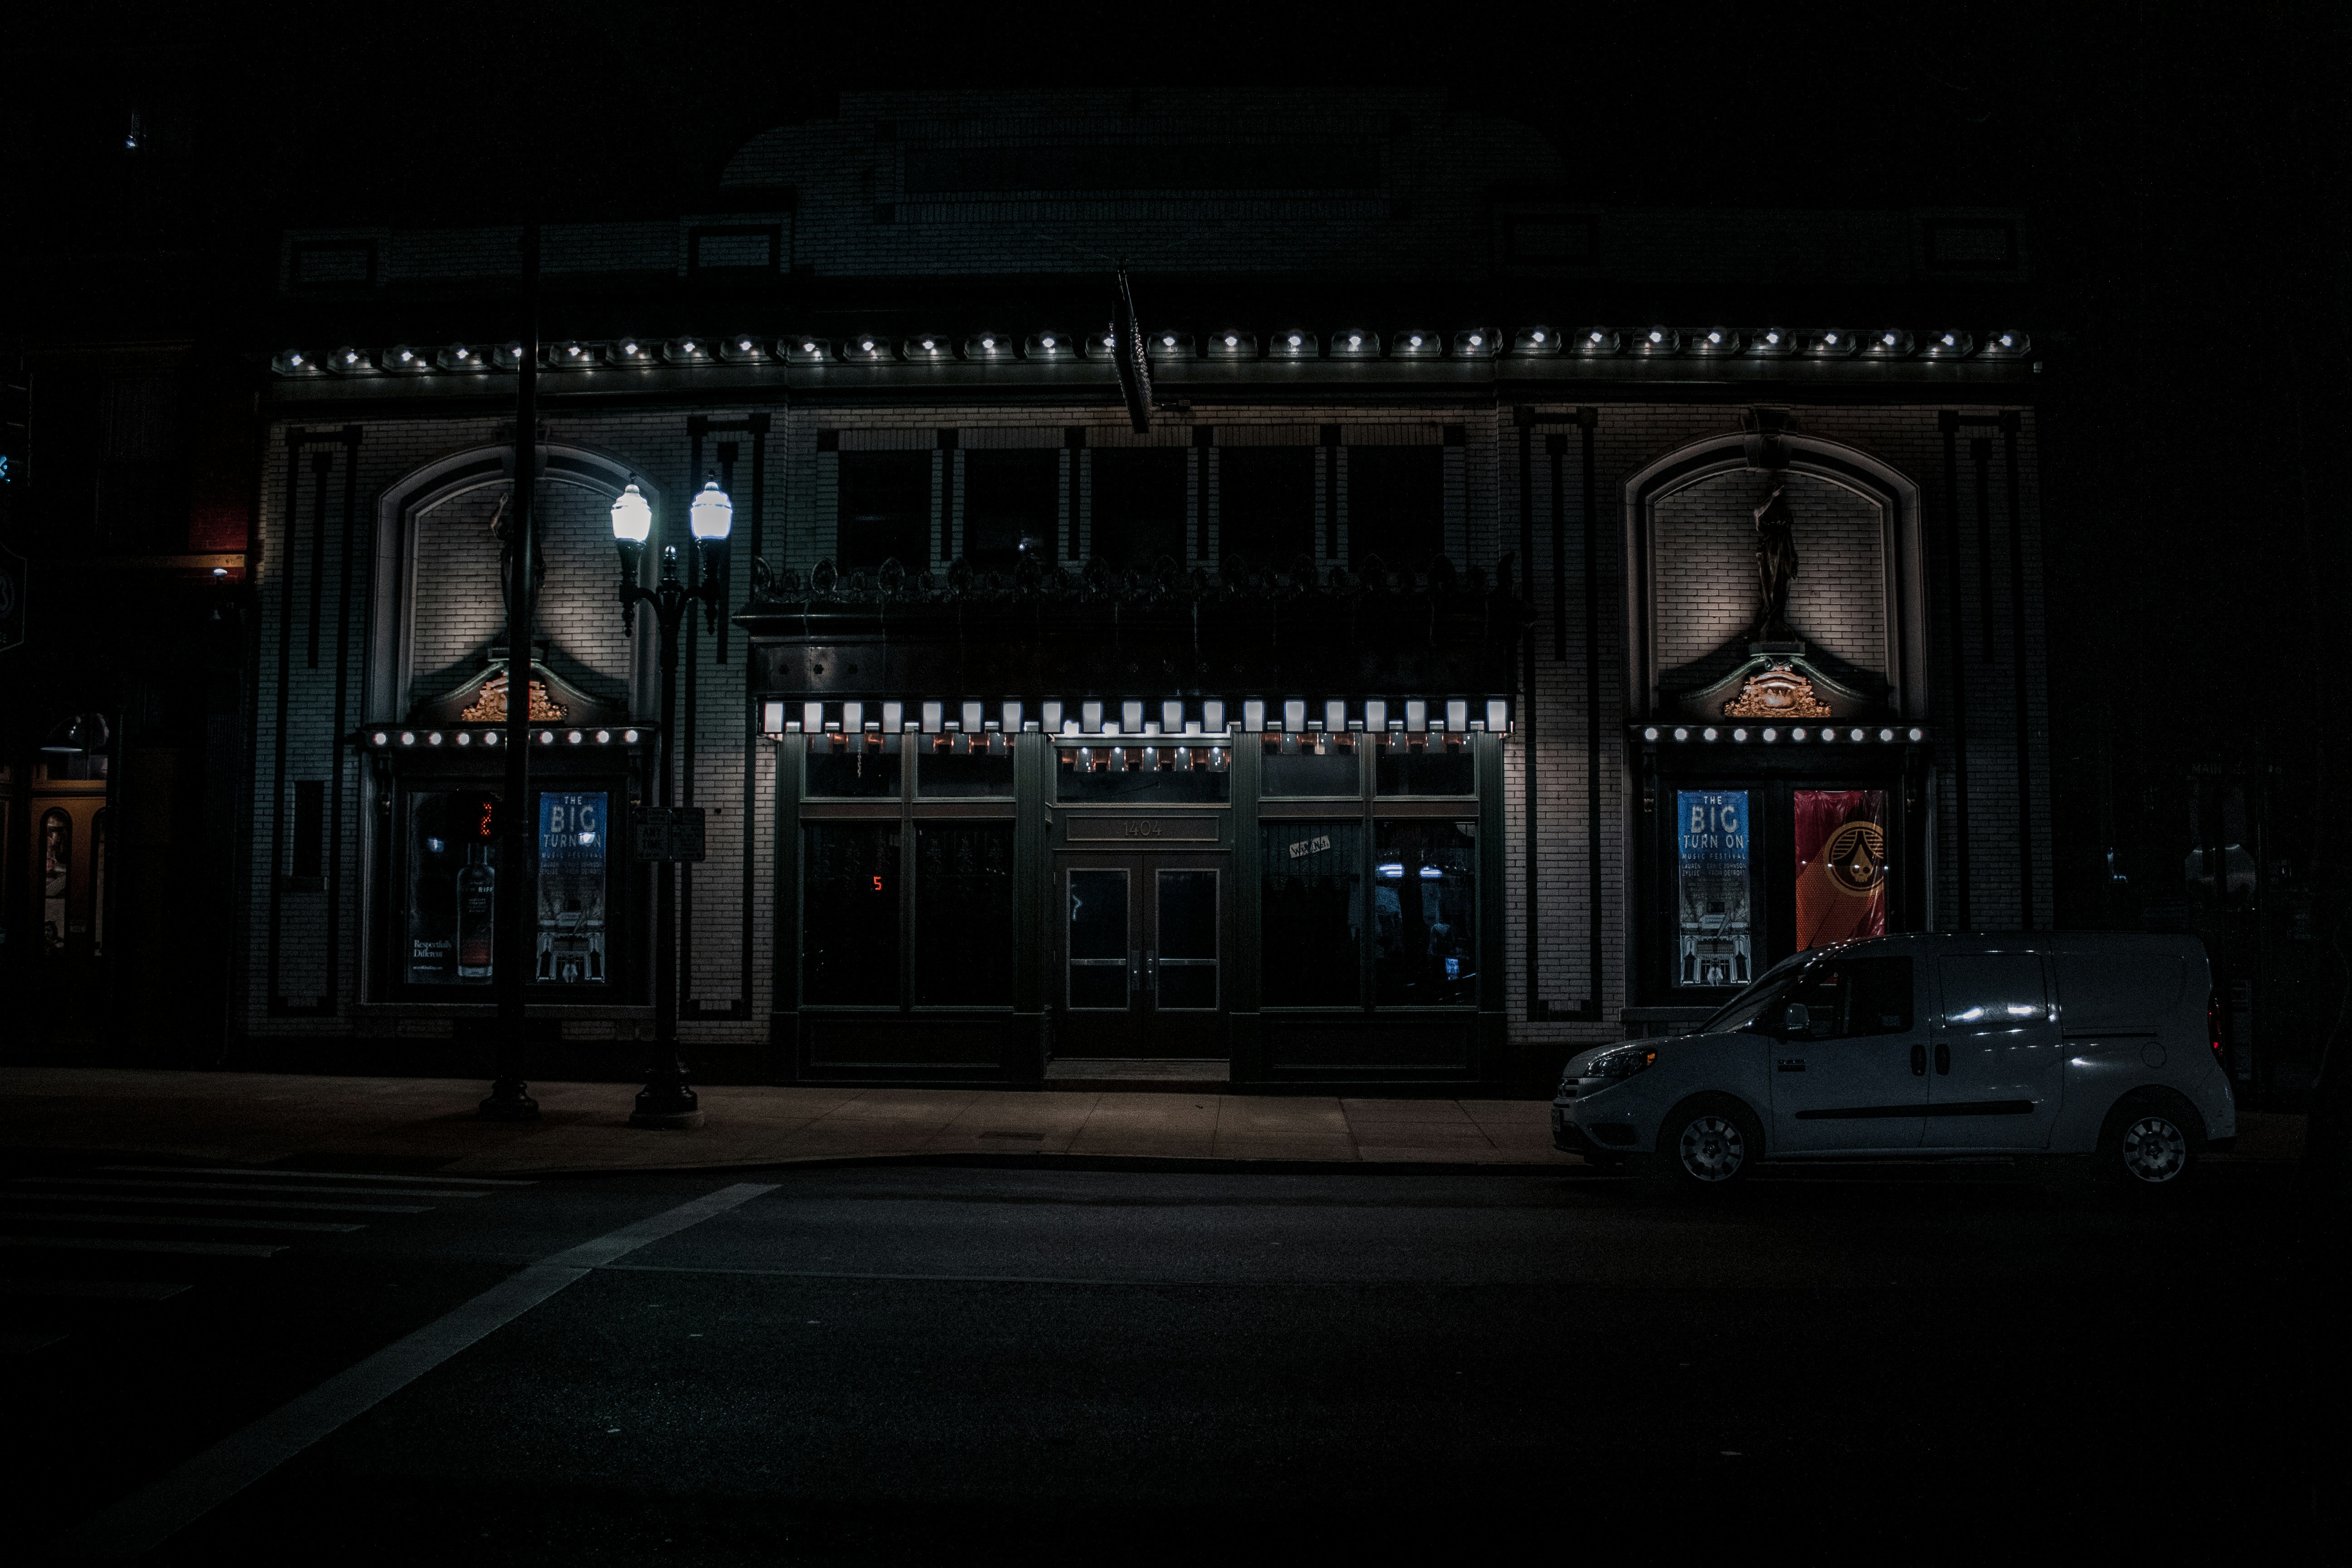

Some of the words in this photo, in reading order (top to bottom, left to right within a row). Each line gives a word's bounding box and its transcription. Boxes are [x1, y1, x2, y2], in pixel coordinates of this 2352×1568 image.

[2191, 763, 2222, 774] MAIN
[564, 796, 582, 805] THE
[1703, 796, 1722, 804] THE
[479, 802, 492, 836] 2
[551, 805, 595, 833] BIG
[1691, 806, 1738, 833] BIG
[643, 827, 660, 838] ANY
[1123, 820, 1162, 837] 1404
[544, 834, 577, 848] TURN
[1683, 834, 1718, 848] TURN
[1725, 834, 1744, 848] ON
[414, 939, 451, 951] Respectfully
[413, 949, 443, 958] Different
